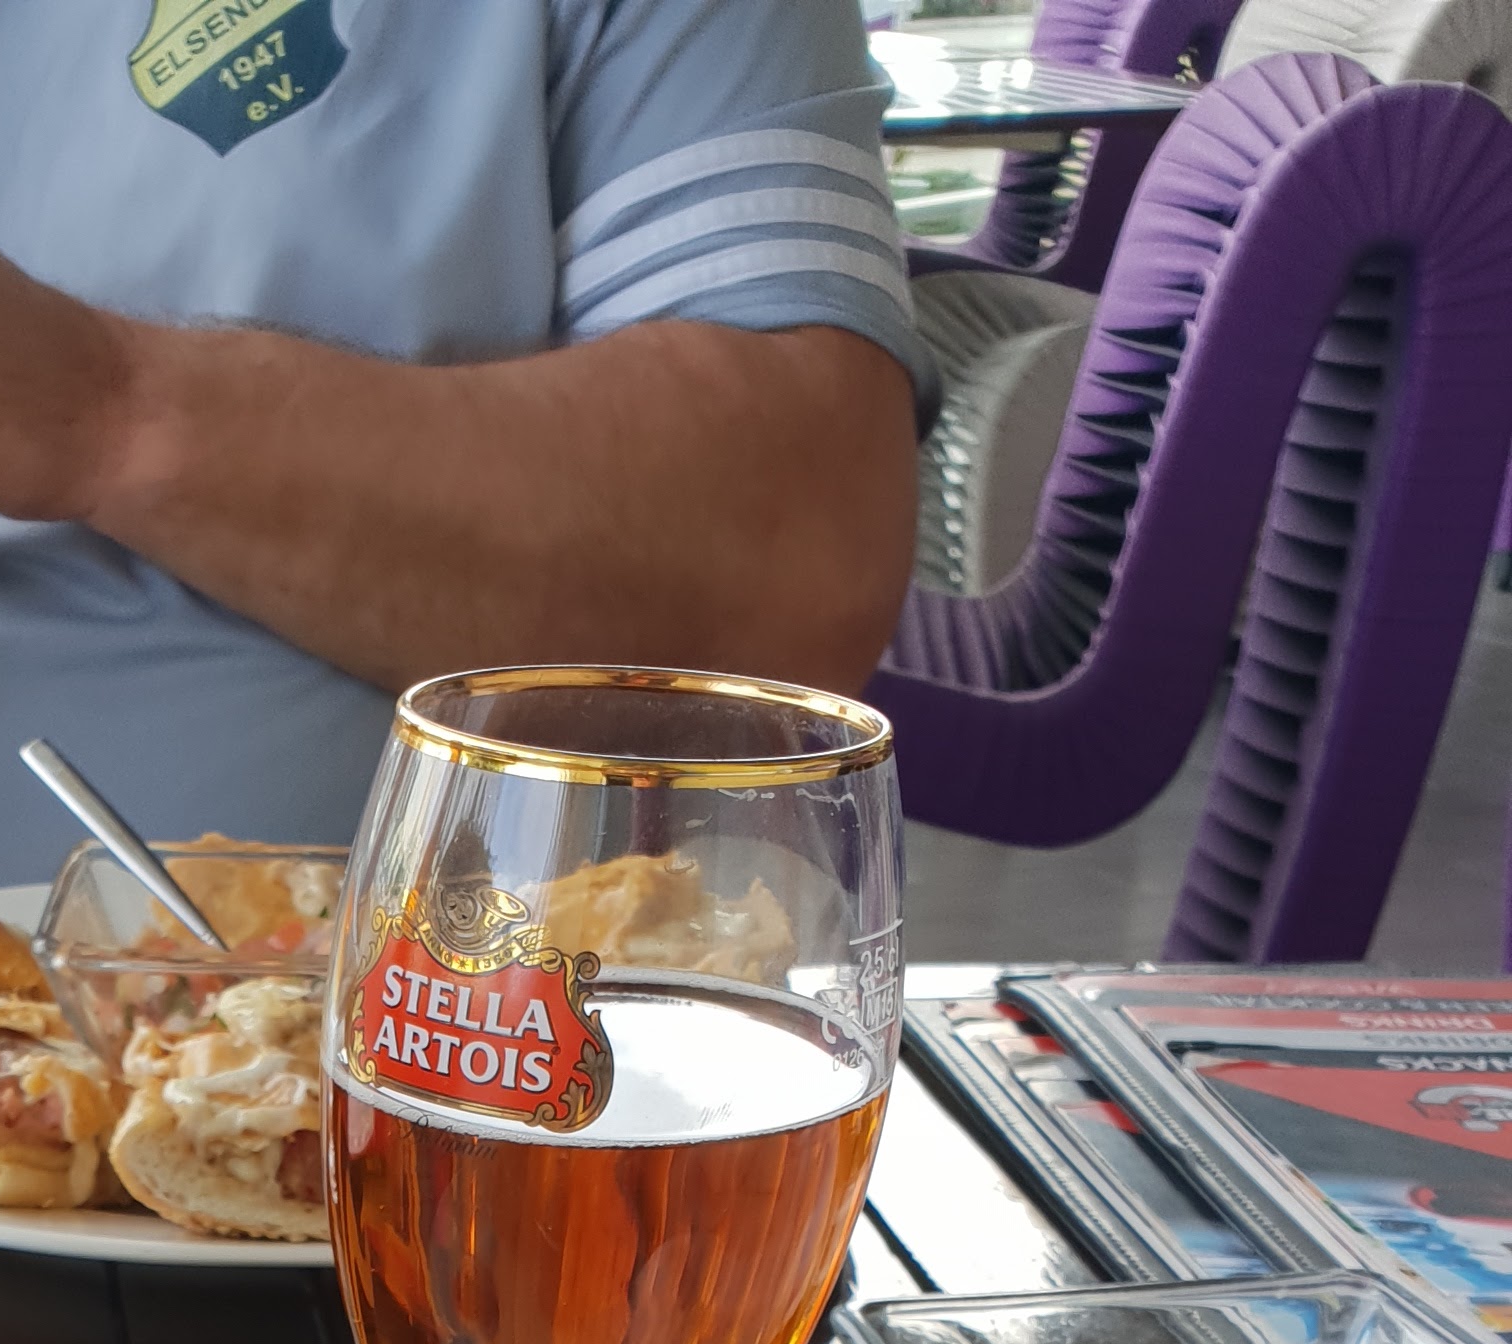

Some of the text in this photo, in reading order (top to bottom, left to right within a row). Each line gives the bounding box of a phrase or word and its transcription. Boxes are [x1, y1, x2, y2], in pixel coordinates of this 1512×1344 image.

[219, 30, 286, 90] 1947
[247, 73, 305, 121] e.V.
[859, 945, 884, 983] 25
[382, 964, 555, 1042] STELLA
[372, 1015, 553, 1093] ARTOIS
